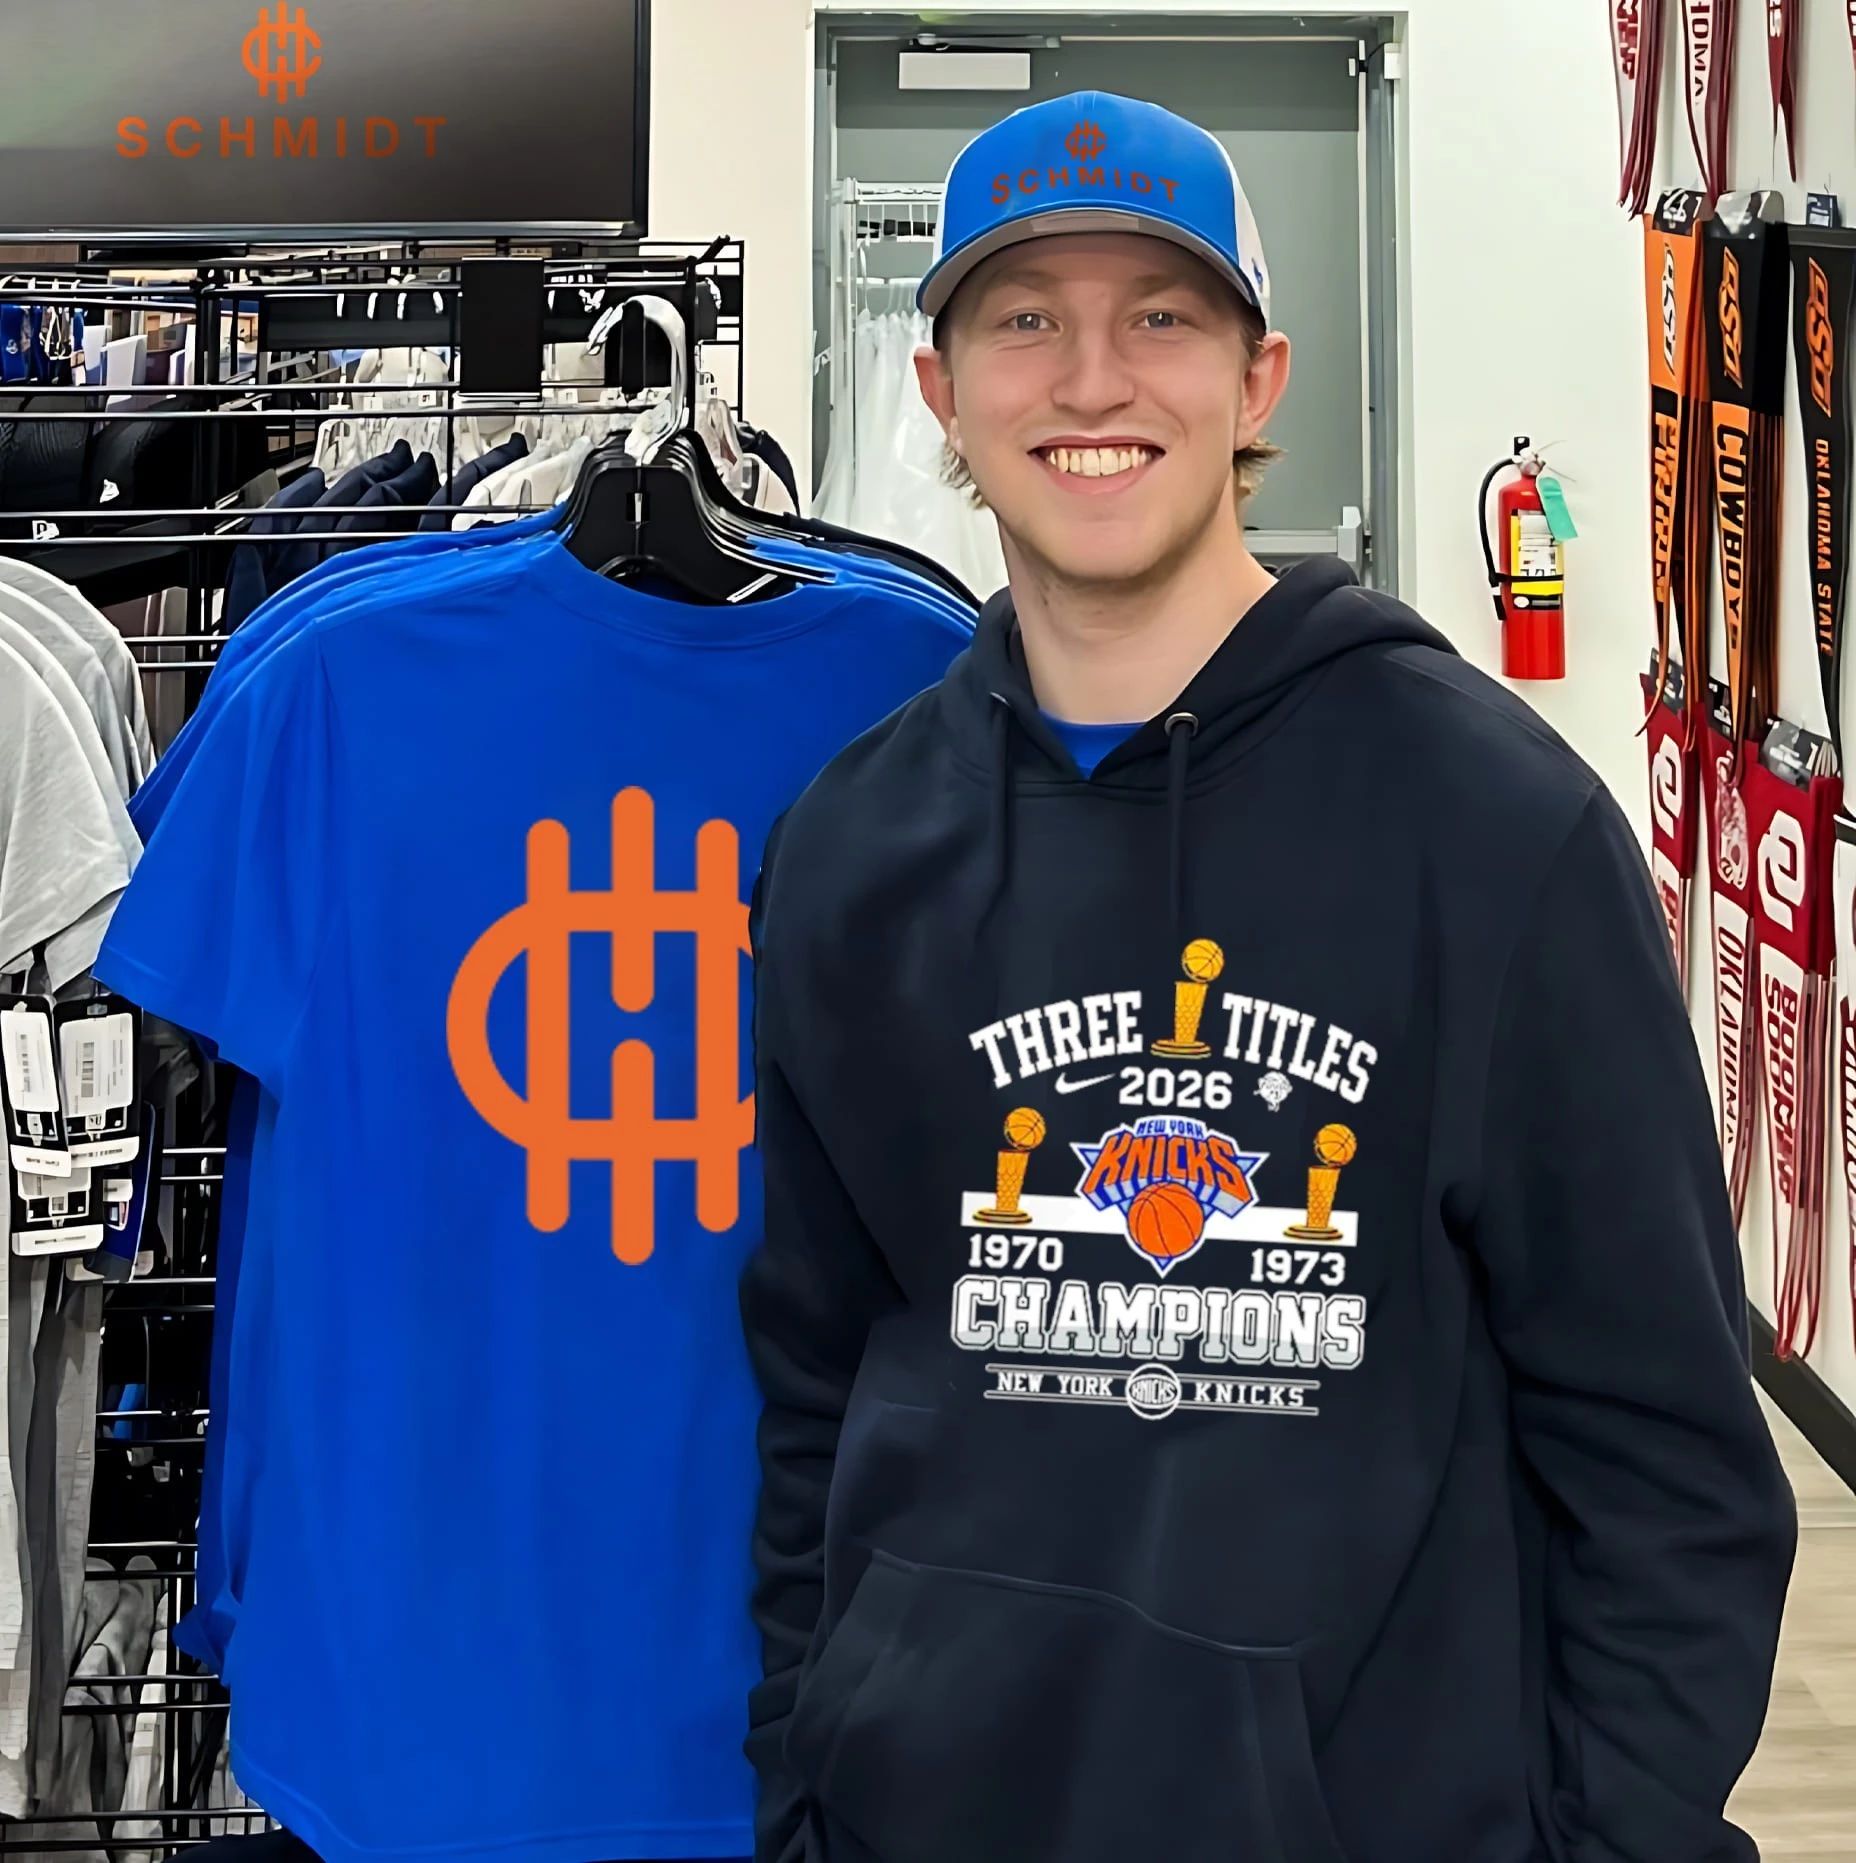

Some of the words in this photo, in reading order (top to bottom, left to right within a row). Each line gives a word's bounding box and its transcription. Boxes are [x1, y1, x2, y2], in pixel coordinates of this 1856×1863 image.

[115, 116, 447, 159] SCHMIDT
[992, 166, 1180, 205] SCHMIDT
[968, 991, 1143, 1088] THREE
[1222, 993, 1378, 1104] TITLES
[1119, 1067, 1233, 1109] 2026
[1136, 1119, 1166, 1135] NEW
[1169, 1119, 1204, 1139] YORK
[1083, 1132, 1255, 1204] KNICKS
[968, 1234, 1063, 1271] 1970
[1251, 1249, 1345, 1286] 1973
[951, 1274, 1366, 1370] CHAMPIONS
[998, 1373, 1041, 1393] NEW
[1059, 1376, 1113, 1397] YORK
[1194, 1383, 1304, 1406] KNICKS
[1132, 1378, 1177, 1402] KNICKS
